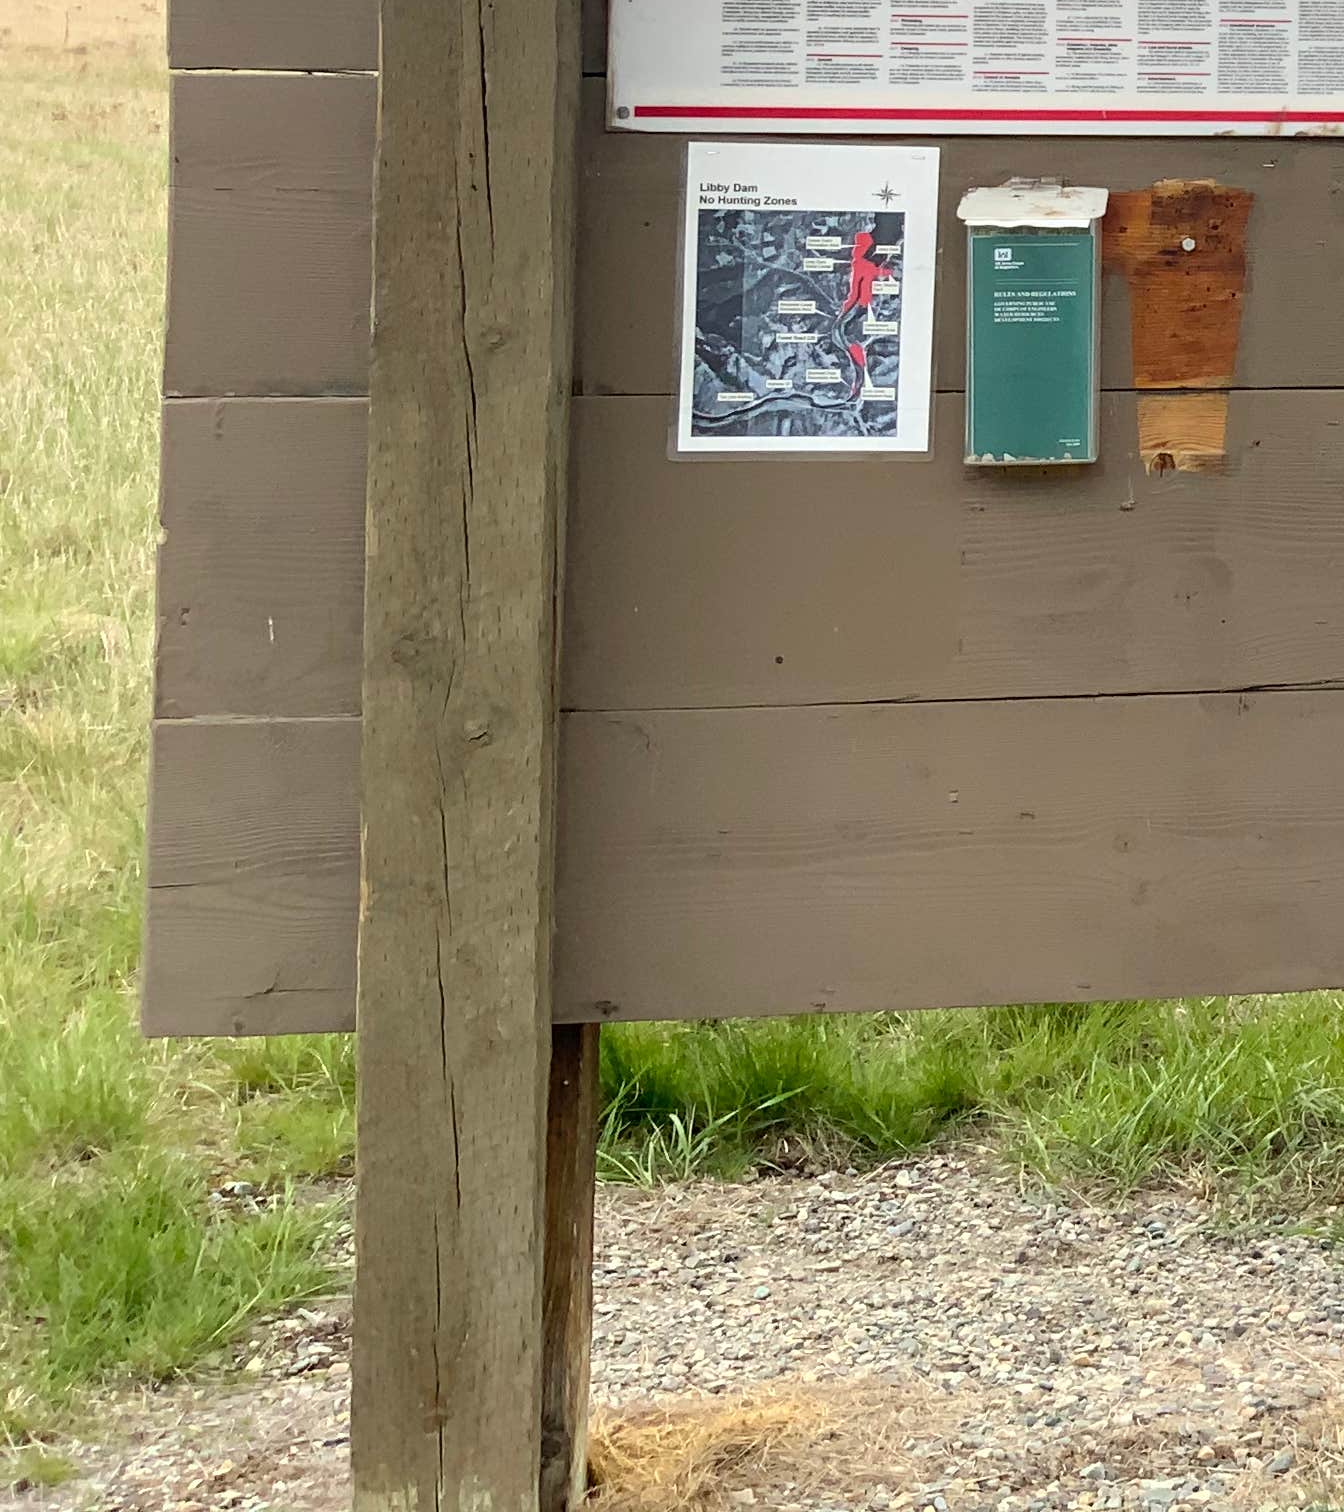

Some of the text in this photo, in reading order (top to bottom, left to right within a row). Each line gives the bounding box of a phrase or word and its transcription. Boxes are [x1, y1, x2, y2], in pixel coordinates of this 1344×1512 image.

[699, 182, 757, 194] Libby Dam
[699, 195, 797, 207] No Hunting Zones
